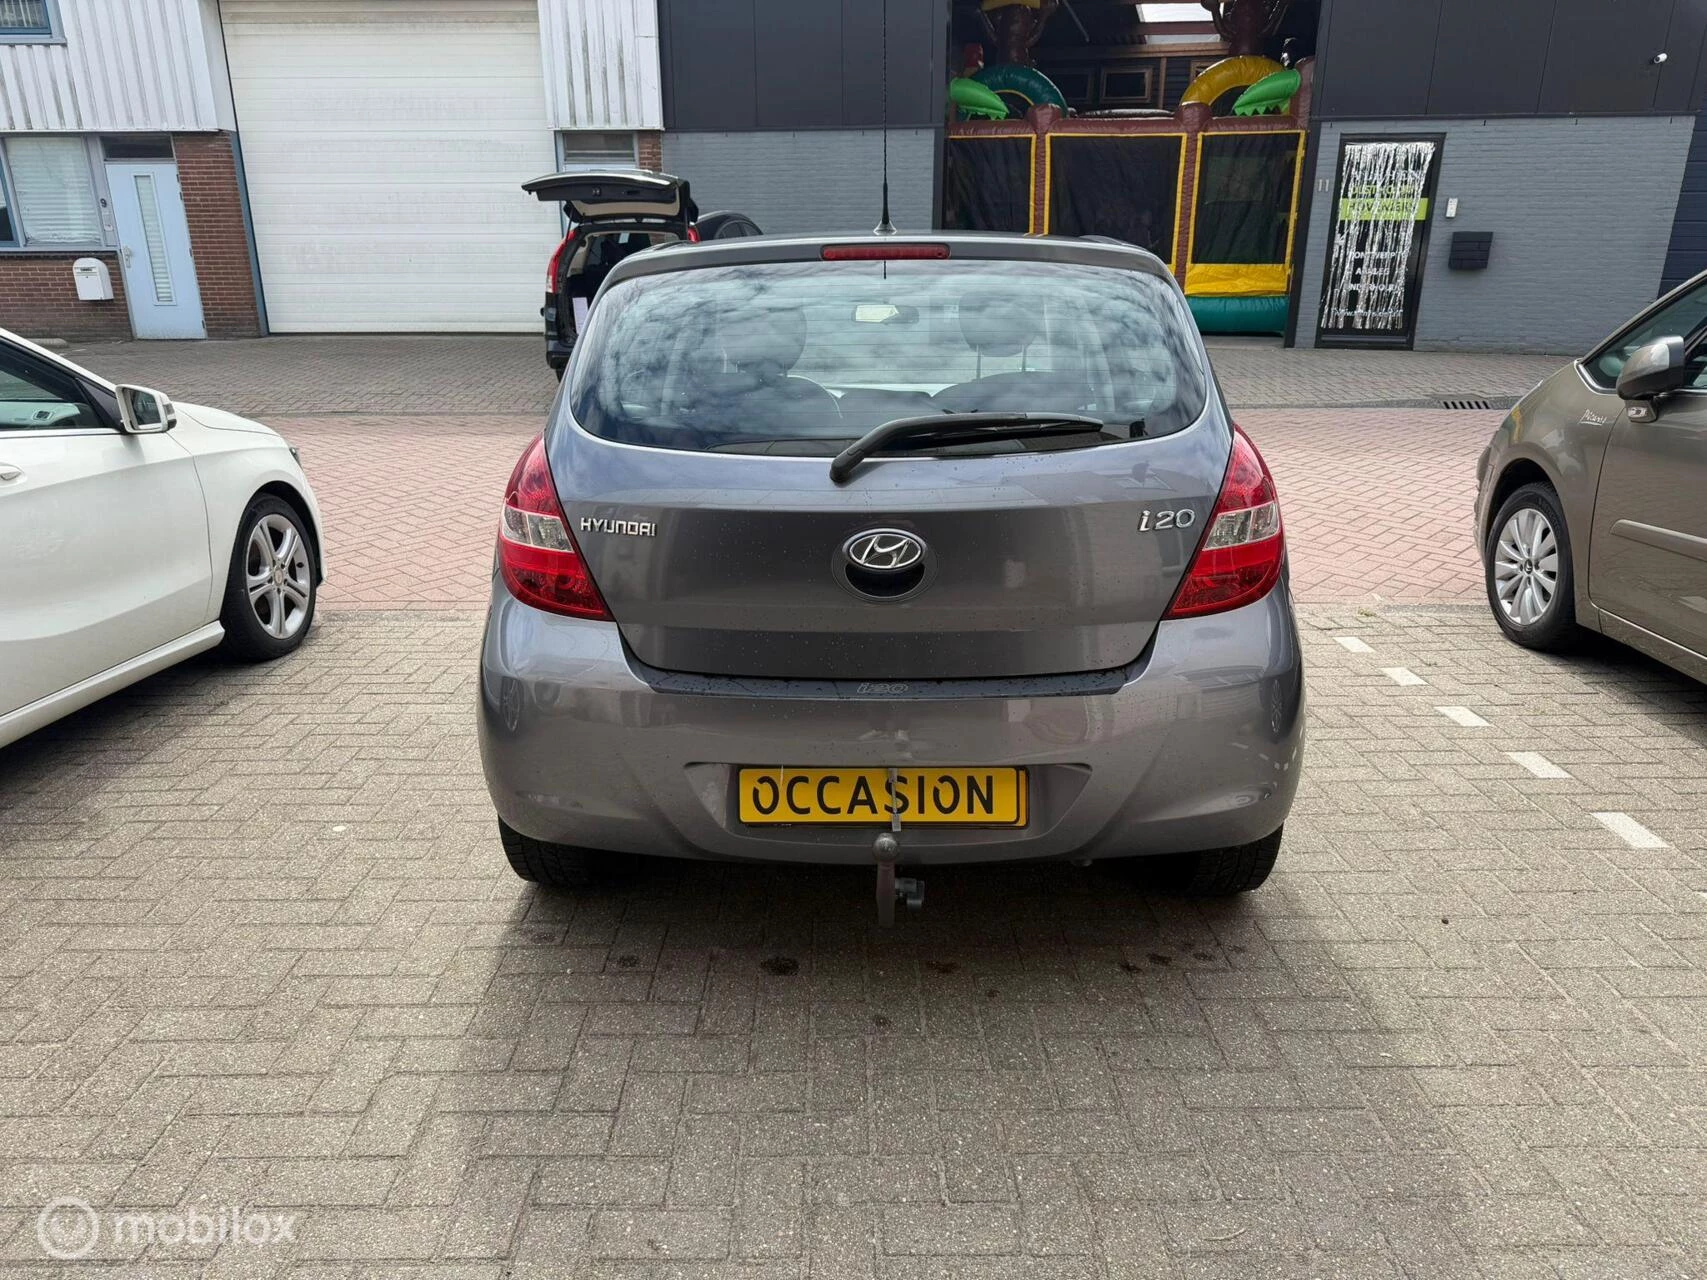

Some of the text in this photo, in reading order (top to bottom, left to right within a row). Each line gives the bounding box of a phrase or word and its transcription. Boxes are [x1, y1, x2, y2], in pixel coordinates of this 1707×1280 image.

[1317, 179, 1330, 192] 11
[100, 198, 107, 208] 9
[1348, 201, 1415, 212] HOVNIERS
[1355, 267, 1390, 275] ANLEG
[1139, 508, 1196, 532] i20
[580, 517, 657, 537] HYUNDAI
[857, 682, 909, 694] i20
[752, 775, 993, 815] OCCASION
